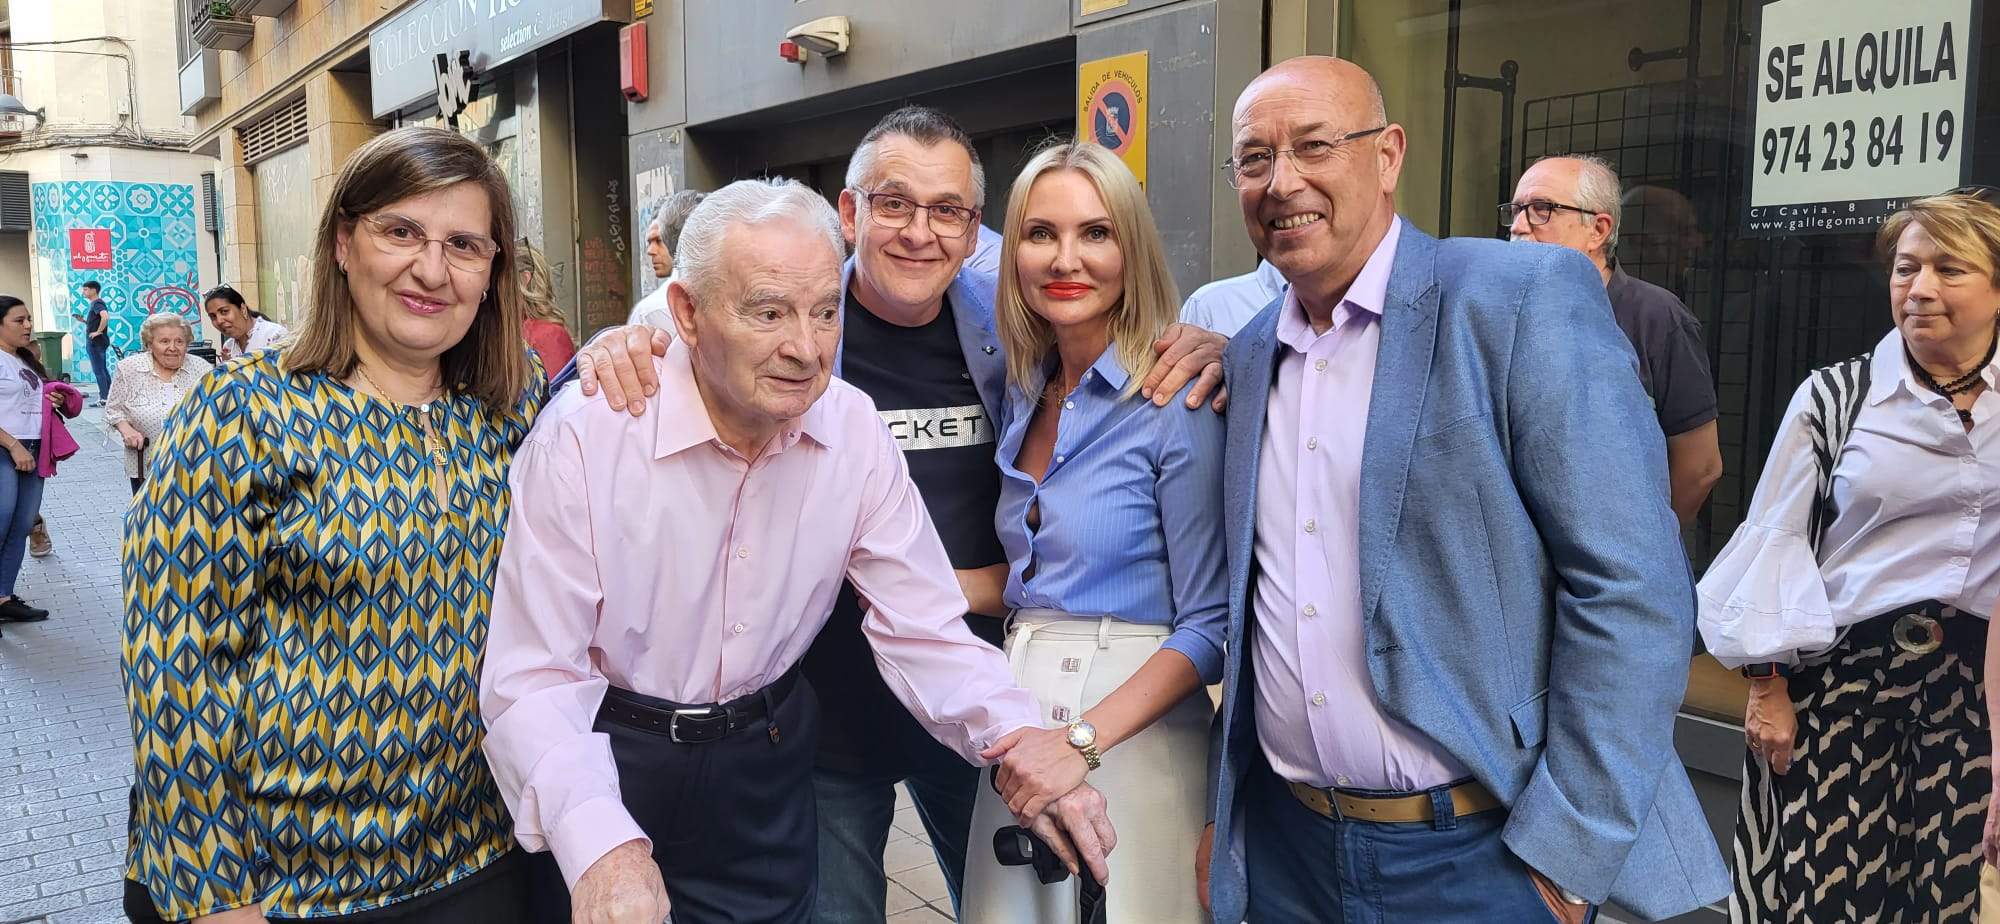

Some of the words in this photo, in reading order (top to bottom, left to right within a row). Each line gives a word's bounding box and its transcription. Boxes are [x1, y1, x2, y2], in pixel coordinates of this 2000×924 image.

[500, 20, 532, 53] selection
[1765, 43, 1806, 104] SE
[1813, 21, 1957, 96] ALQUILA
[1084, 81, 1101, 113] SALIDA
[1101, 71, 1112, 83] DE
[1114, 70, 1143, 105] VEHICULOS
[1761, 124, 1812, 176] 974
[1821, 119, 1856, 172] 23
[1866, 114, 1904, 168] 84
[1919, 109, 1956, 164] 19
[1750, 207, 1767, 218] C/
[1779, 205, 1836, 216] Cavia,
[1848, 202, 1856, 213] 8
